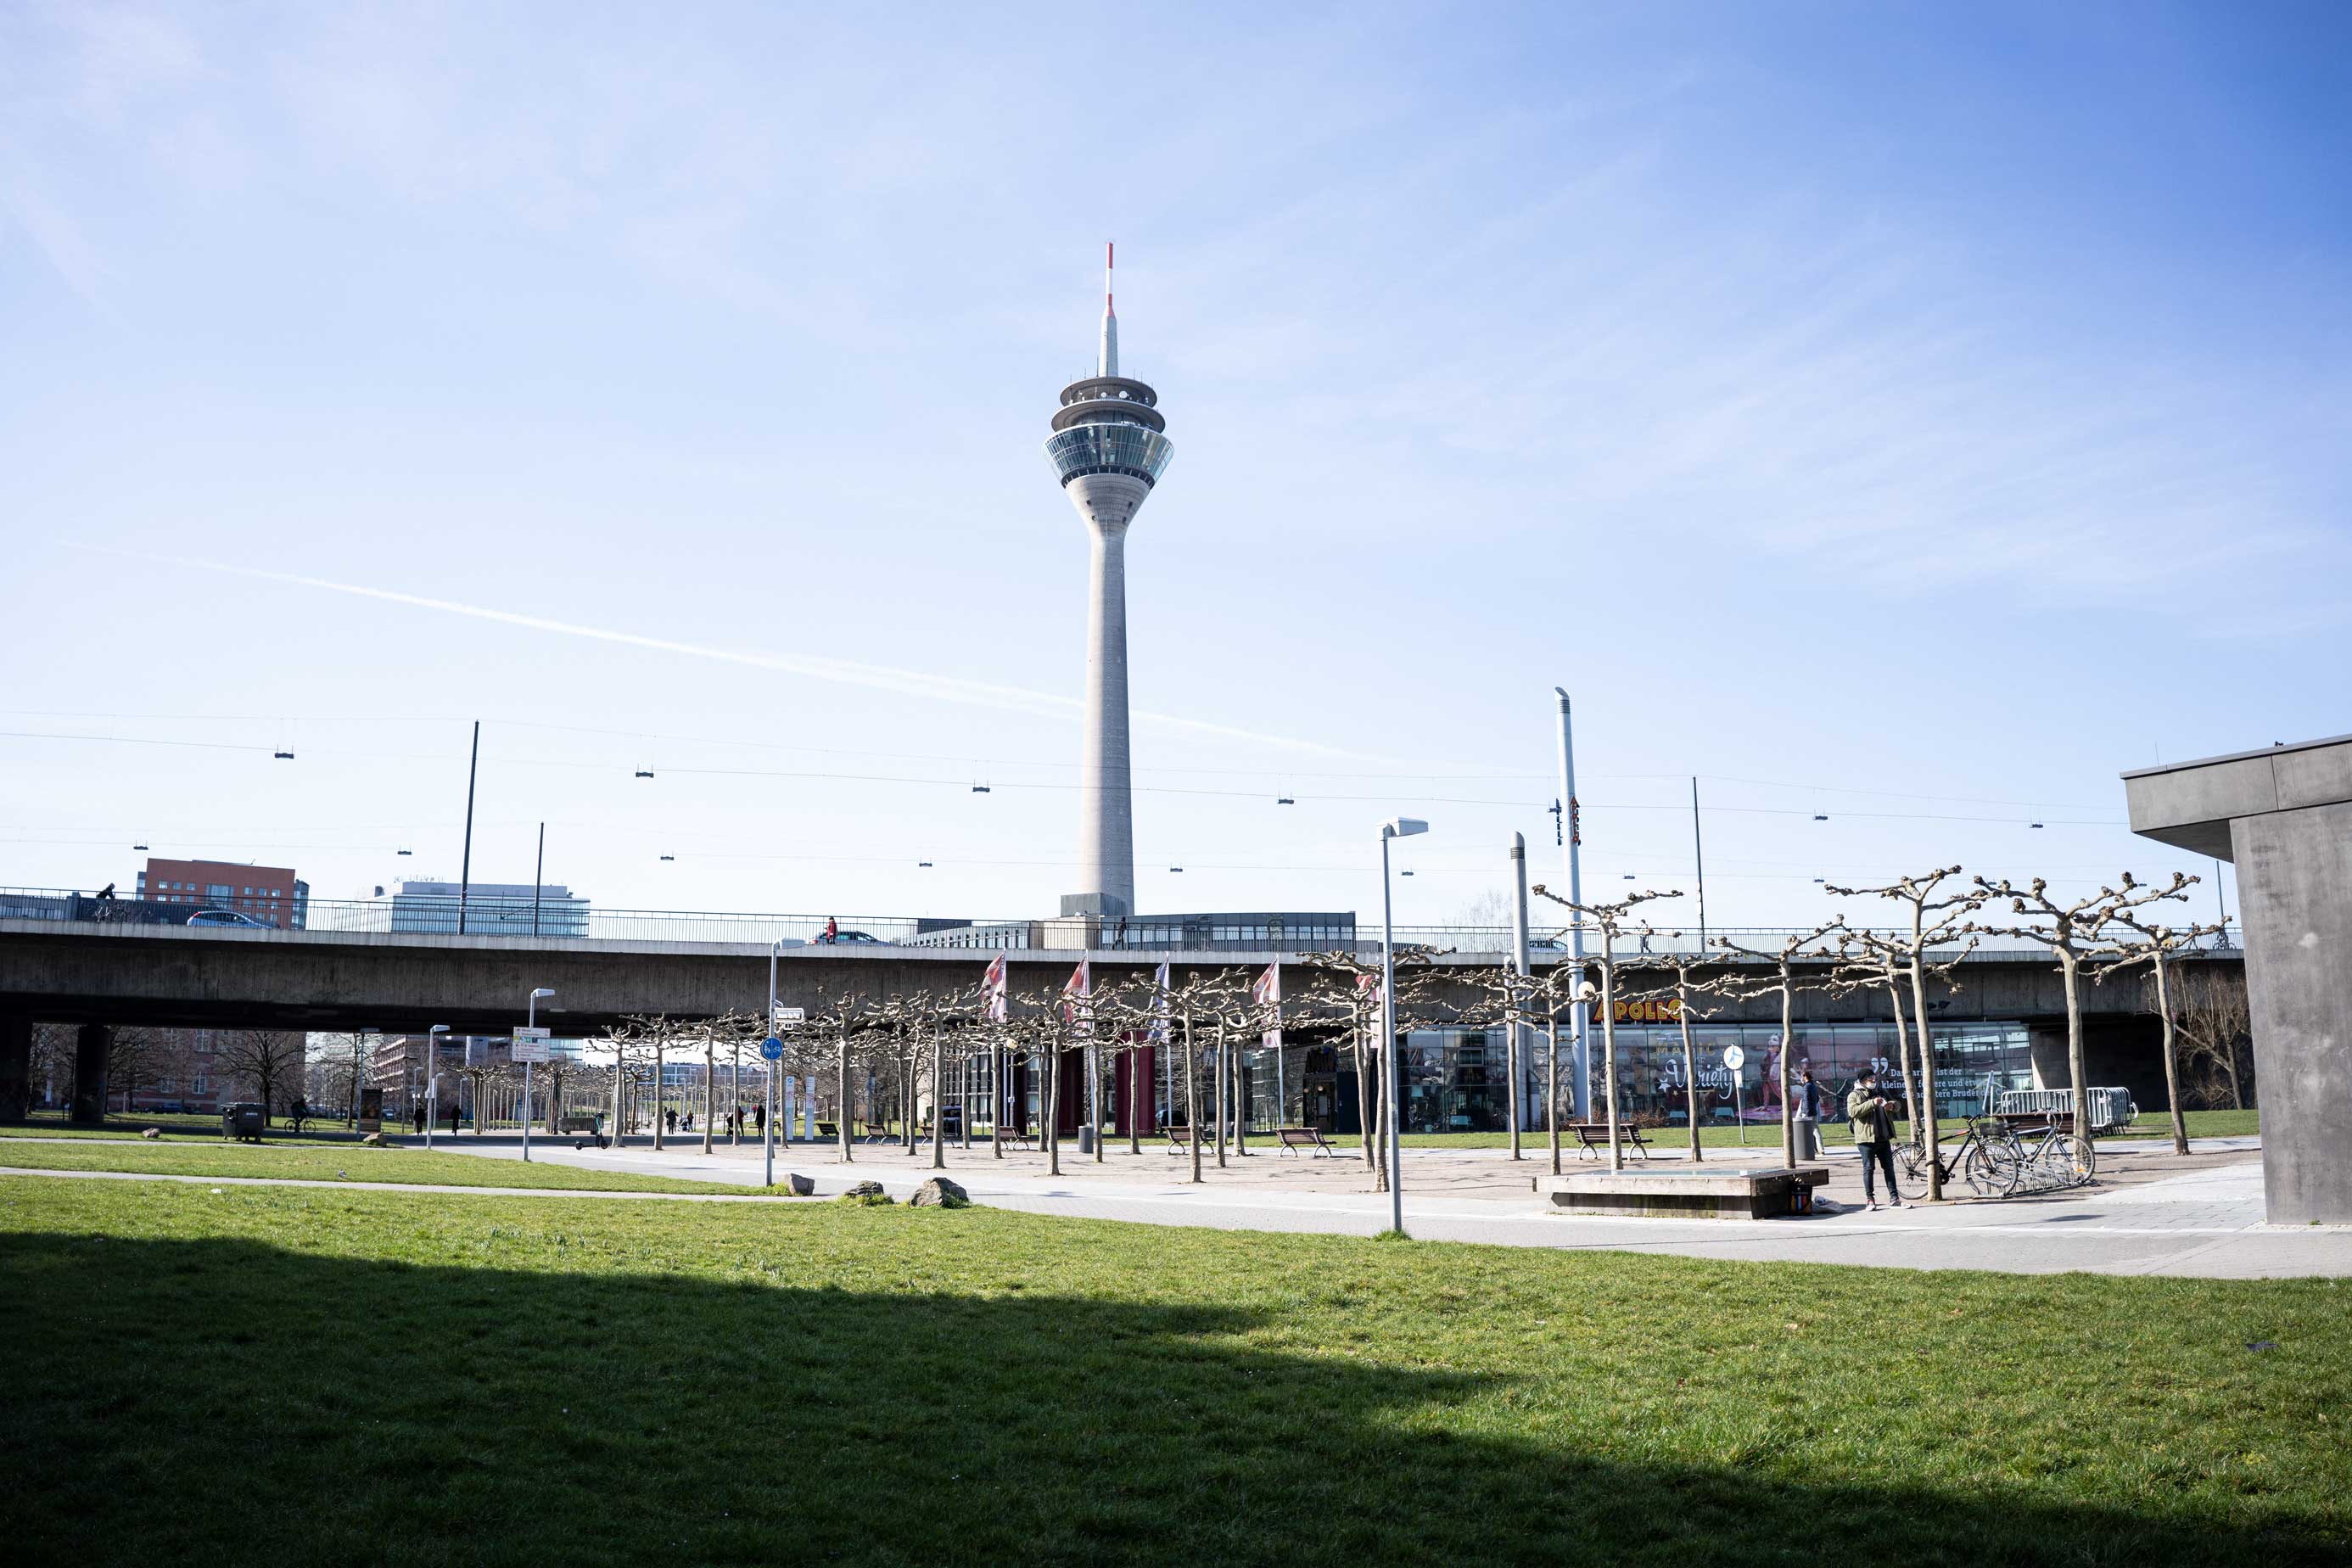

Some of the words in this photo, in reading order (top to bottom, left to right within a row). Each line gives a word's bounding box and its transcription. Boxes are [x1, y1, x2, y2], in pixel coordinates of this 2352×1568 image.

[1656, 1041, 1715, 1056] MAIC
[1665, 1055, 1733, 1100] Vriety
[1890, 1068, 1904, 1077] Da
[1949, 1067, 1962, 1075] der
[1947, 1078, 1963, 1087] und
